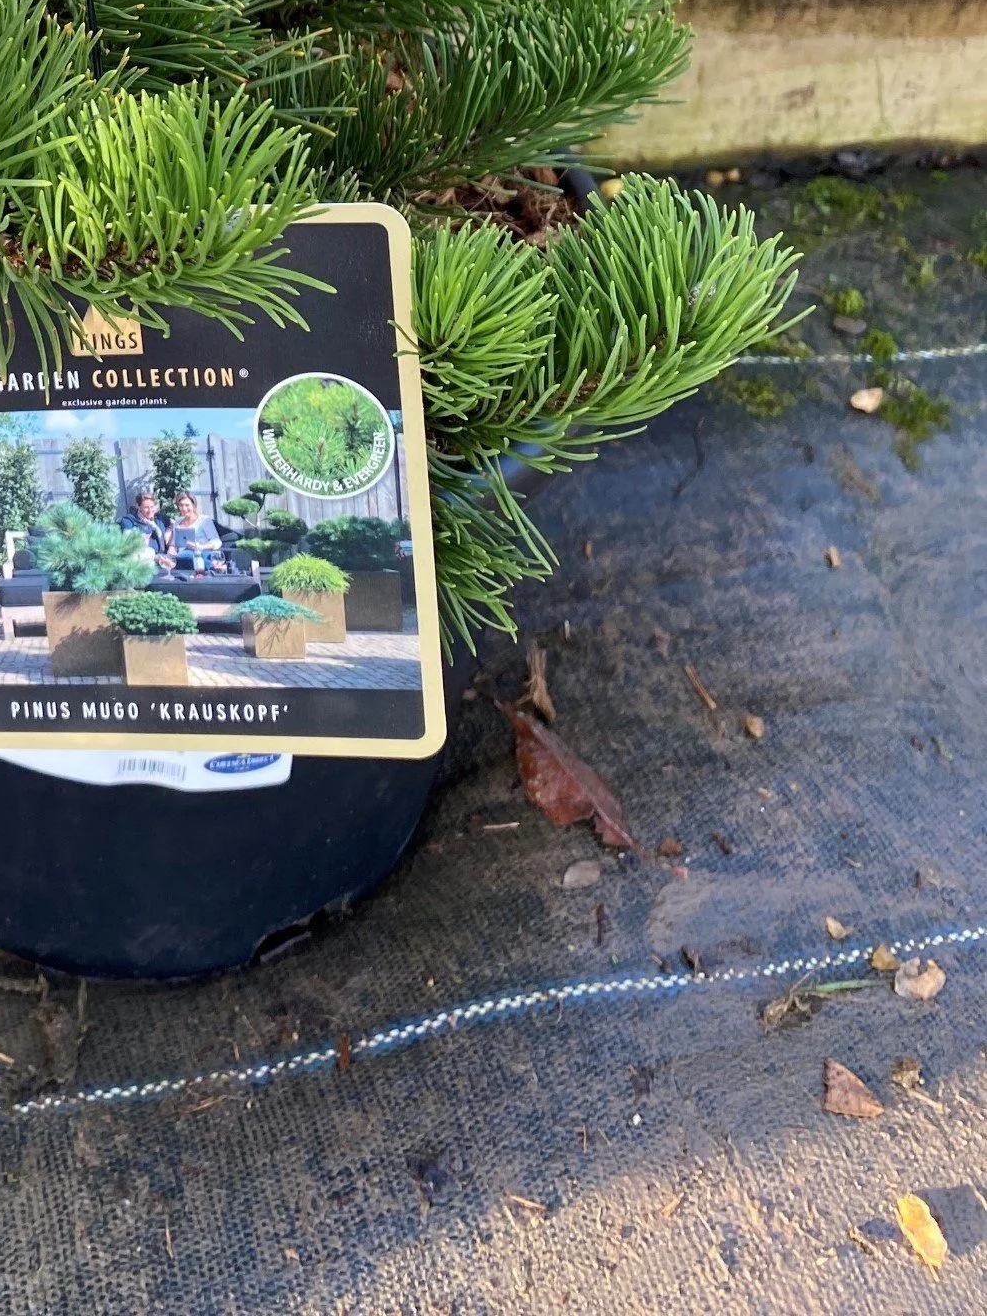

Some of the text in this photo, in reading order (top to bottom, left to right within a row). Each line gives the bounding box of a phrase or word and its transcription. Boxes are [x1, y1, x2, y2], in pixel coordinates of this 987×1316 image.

[61, 396, 168, 407] exclusive garden plants
[262, 428, 386, 492] WINTERHARDY & EVERGREEN
[11, 701, 71, 720] PINUS
[82, 701, 140, 721] MUGO
